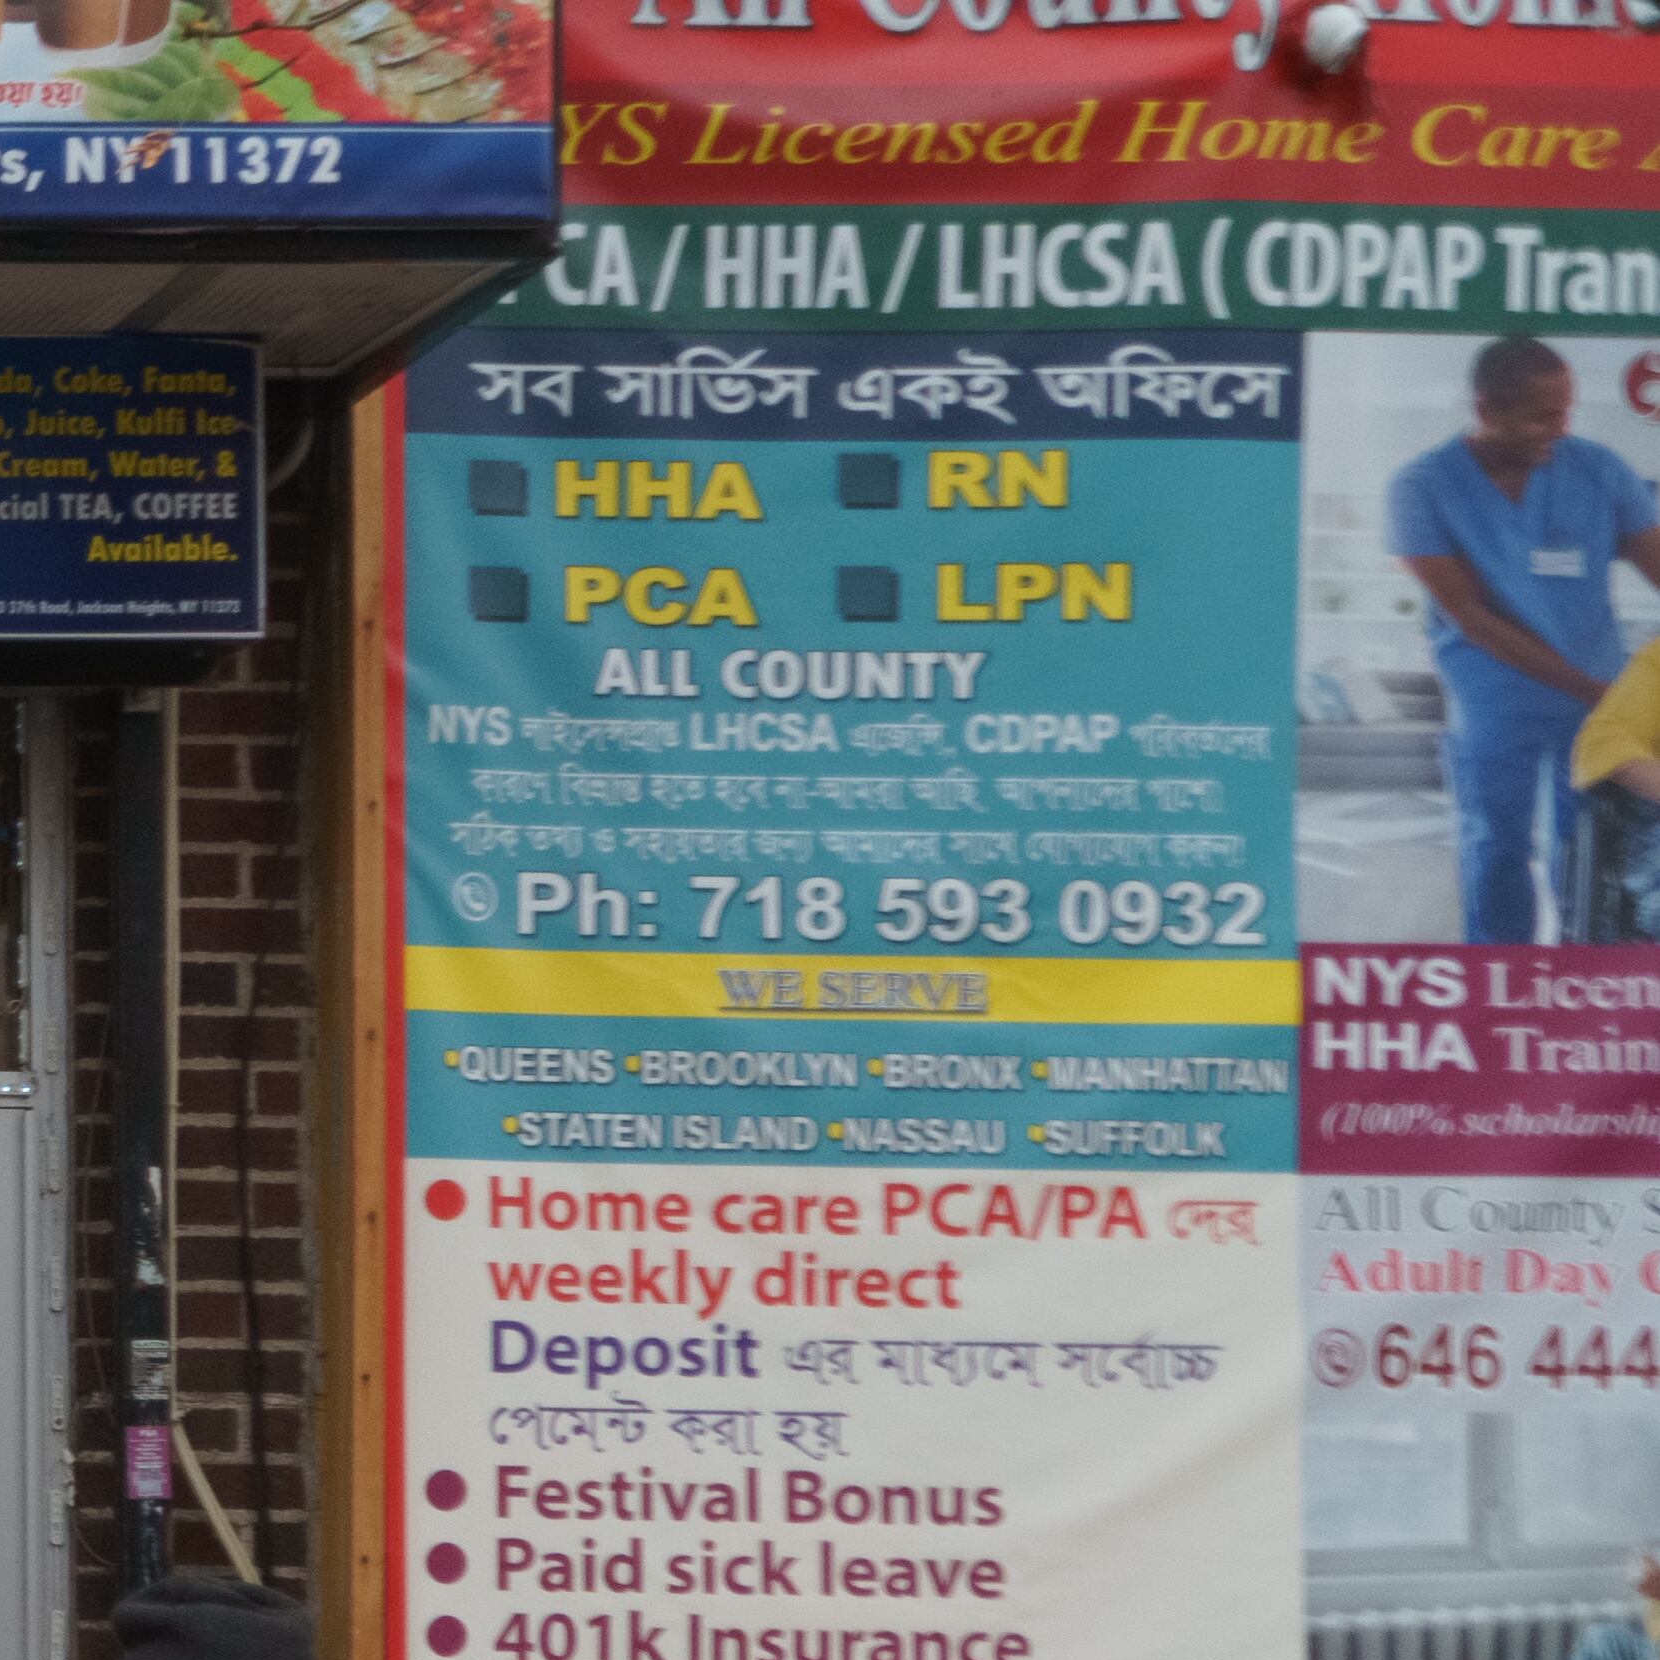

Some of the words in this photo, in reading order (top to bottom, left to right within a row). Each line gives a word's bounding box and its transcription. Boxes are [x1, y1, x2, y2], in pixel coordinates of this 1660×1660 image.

[170, 137, 343, 184] 11372
[685, 97, 1092, 167] Licensed
[1114, 99, 1385, 166] Home
[1409, 103, 1623, 172] Care
[704, 222, 870, 310] HHA
[936, 220, 1186, 309] LHCSA
[1243, 221, 1481, 313] CDPAP
[54, 366, 133, 397] Coke,
[142, 366, 237, 398] Fanta,
[469, 360, 584, 418] সব
[838, 352, 1020, 425] একই
[1033, 345, 1290, 420] অফিসে
[23, 407, 106, 439] Juice,
[108, 449, 206, 482] Water,
[215, 449, 239, 478] &
[554, 459, 765, 522] HHA
[927, 449, 1070, 510] RN
[59, 491, 125, 524] TEA,
[132, 491, 240, 520] COFFEE
[86, 532, 240, 563] Available.
[563, 566, 760, 628] PCA
[935, 562, 1132, 624] LPN
[514, 871, 658, 938] Ph:
[688, 874, 848, 941] 718
[874, 876, 1030, 944] 593
[1058, 878, 1268, 948] 0932
[717, 967, 803, 1012] WE
[817, 970, 990, 1014] SERVE
[459, 1045, 616, 1085] QUEENS
[641, 1047, 858, 1088] BROOKLYN
[884, 1051, 1023, 1091] BRONX
[1047, 1054, 1290, 1095] MANHATTAN
[517, 1110, 665, 1151] STATEN
[673, 1112, 821, 1153] ISLAND
[843, 1115, 1007, 1155] NASSAU
[1042, 1119, 1227, 1159] SUFFOLK
[487, 1176, 690, 1233] Home
[712, 1189, 860, 1237] care
[883, 1182, 1149, 1241] PCA/PA
[487, 1249, 733, 1319] weekly
[753, 1251, 964, 1310] direct
[489, 1319, 761, 1388] Deposit
[667, 1409, 762, 1454] করা
[775, 1409, 849, 1460] হয়
[494, 1464, 761, 1526] Festival
[785, 1471, 1008, 1528] Bonus
[494, 1536, 646, 1595] Paid
[665, 1539, 802, 1598] sick
[821, 1541, 1008, 1600] leave
